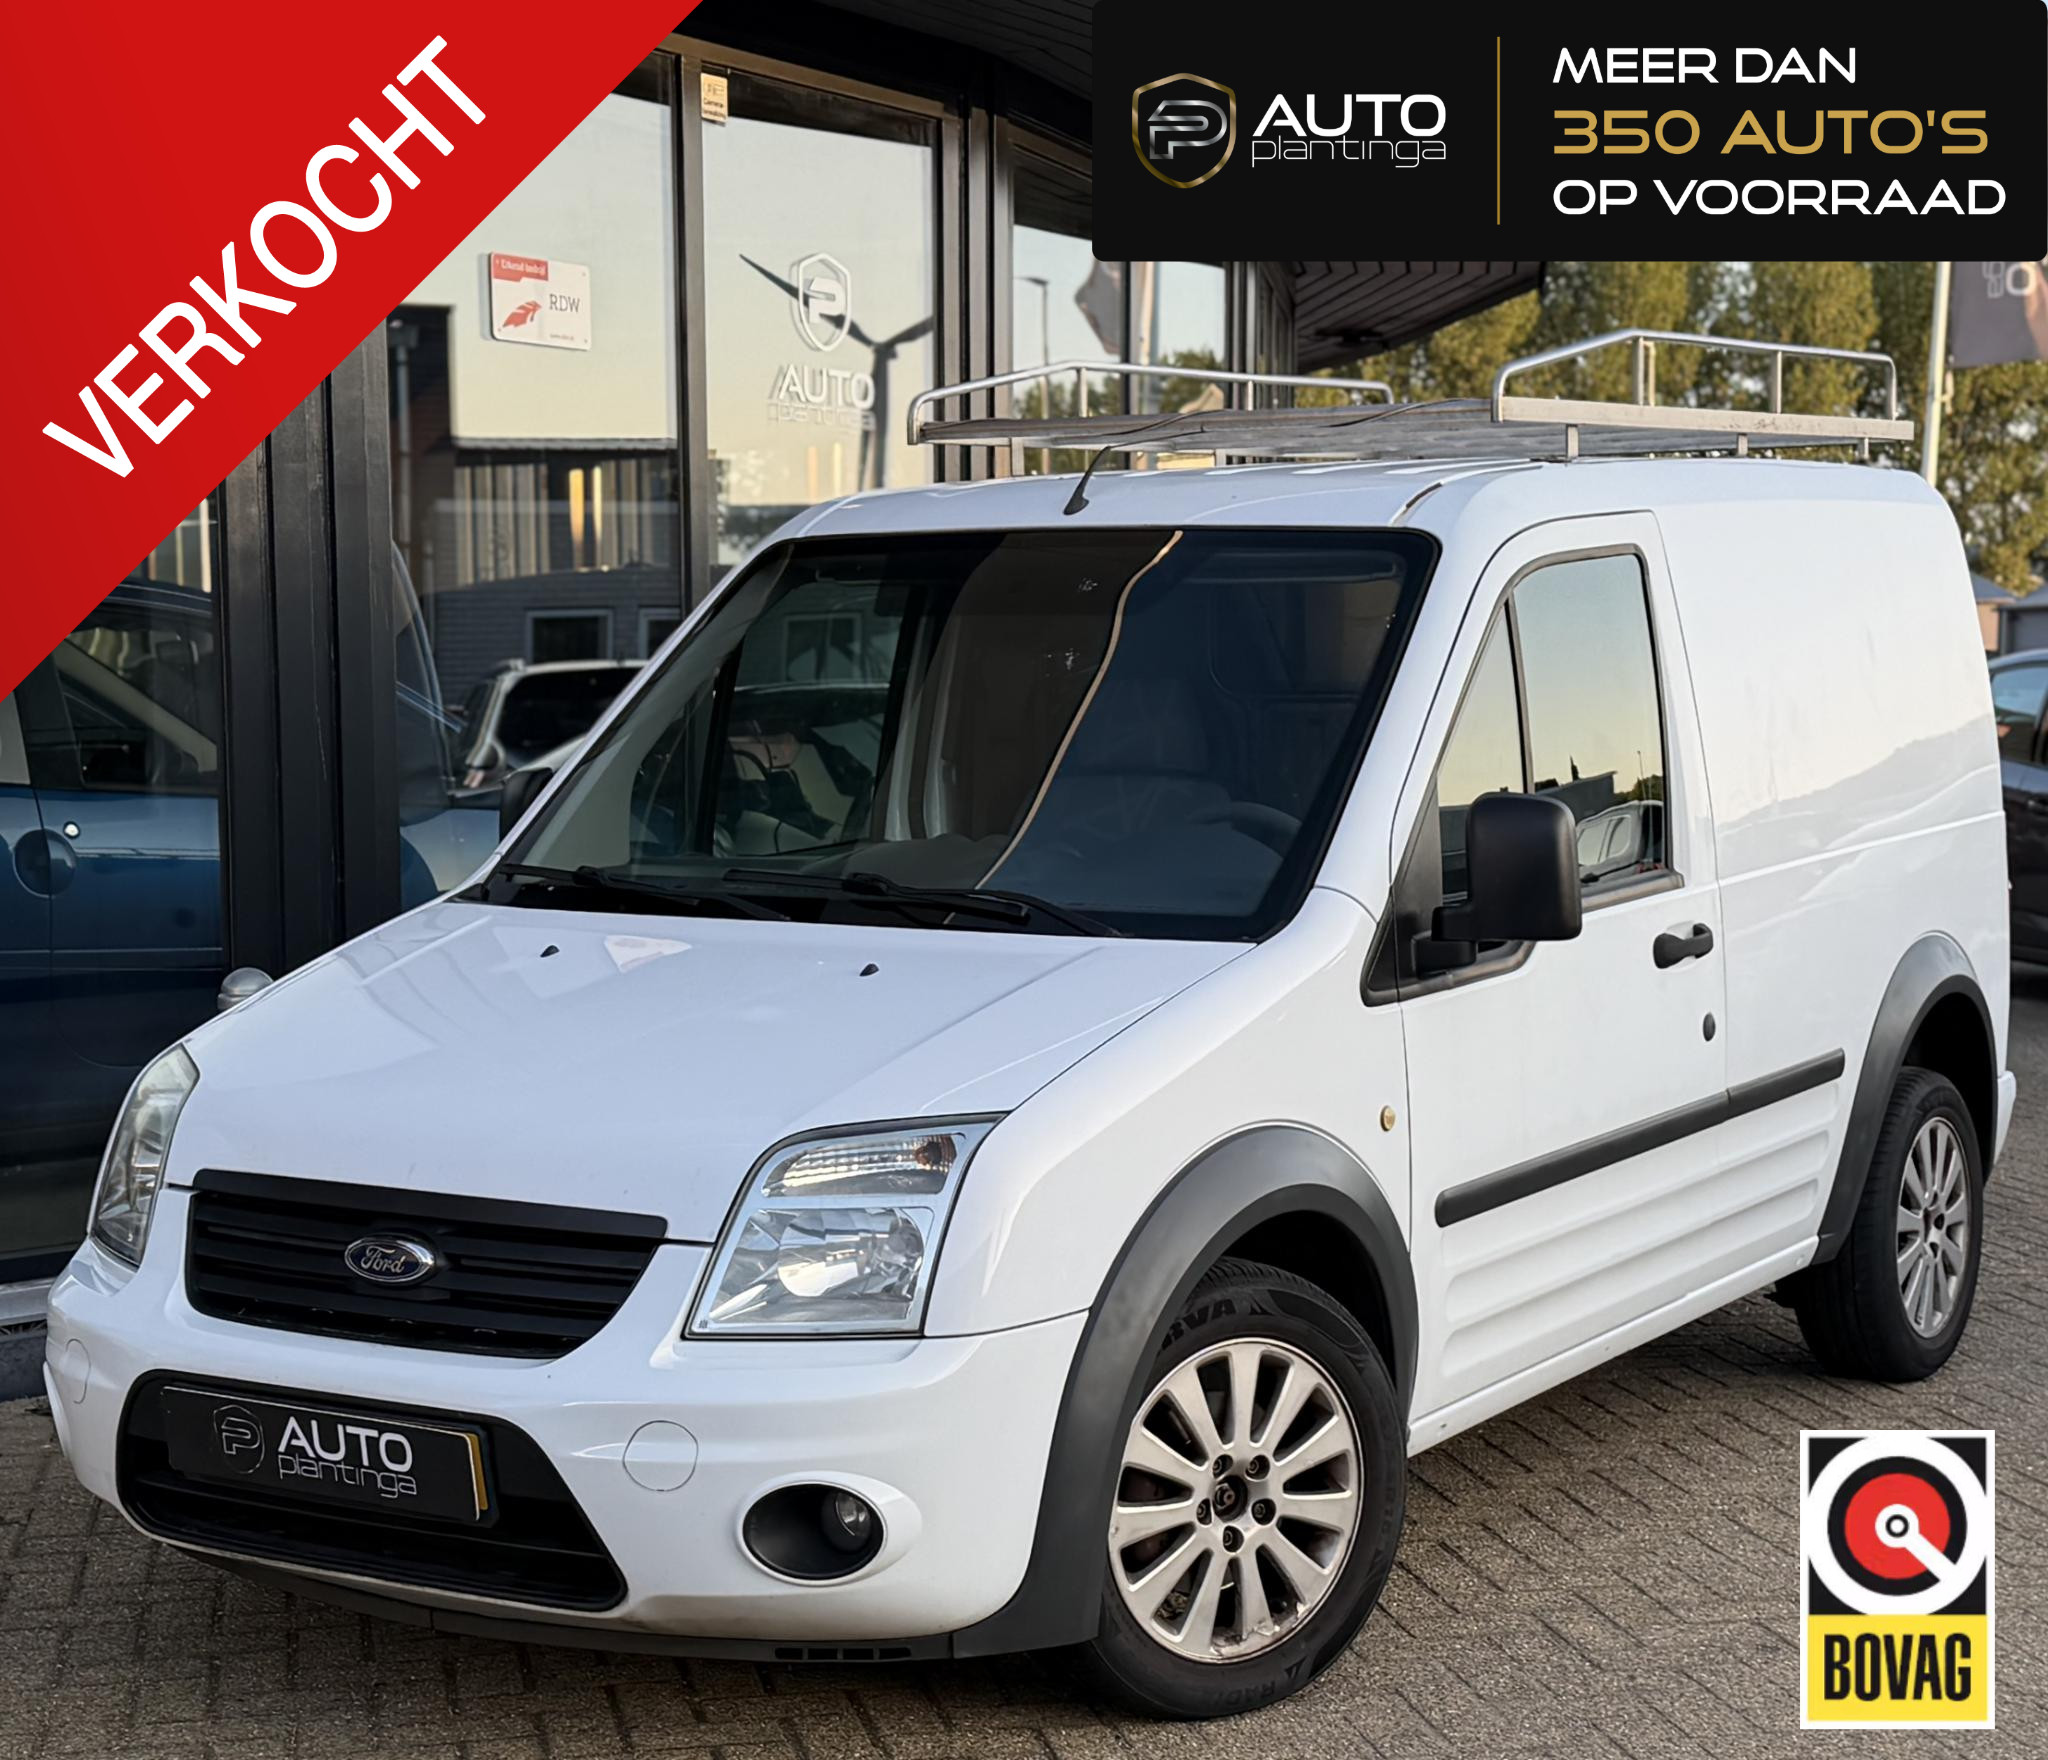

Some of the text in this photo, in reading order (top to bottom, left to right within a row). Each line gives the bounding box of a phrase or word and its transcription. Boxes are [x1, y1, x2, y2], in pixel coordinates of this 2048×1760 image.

[549, 293, 580, 313] RDW
[779, 364, 875, 409] AUTO
[361, 1246, 406, 1273] Ford
[278, 1416, 413, 1473] AUTO
[278, 1453, 417, 1498] plantinga
